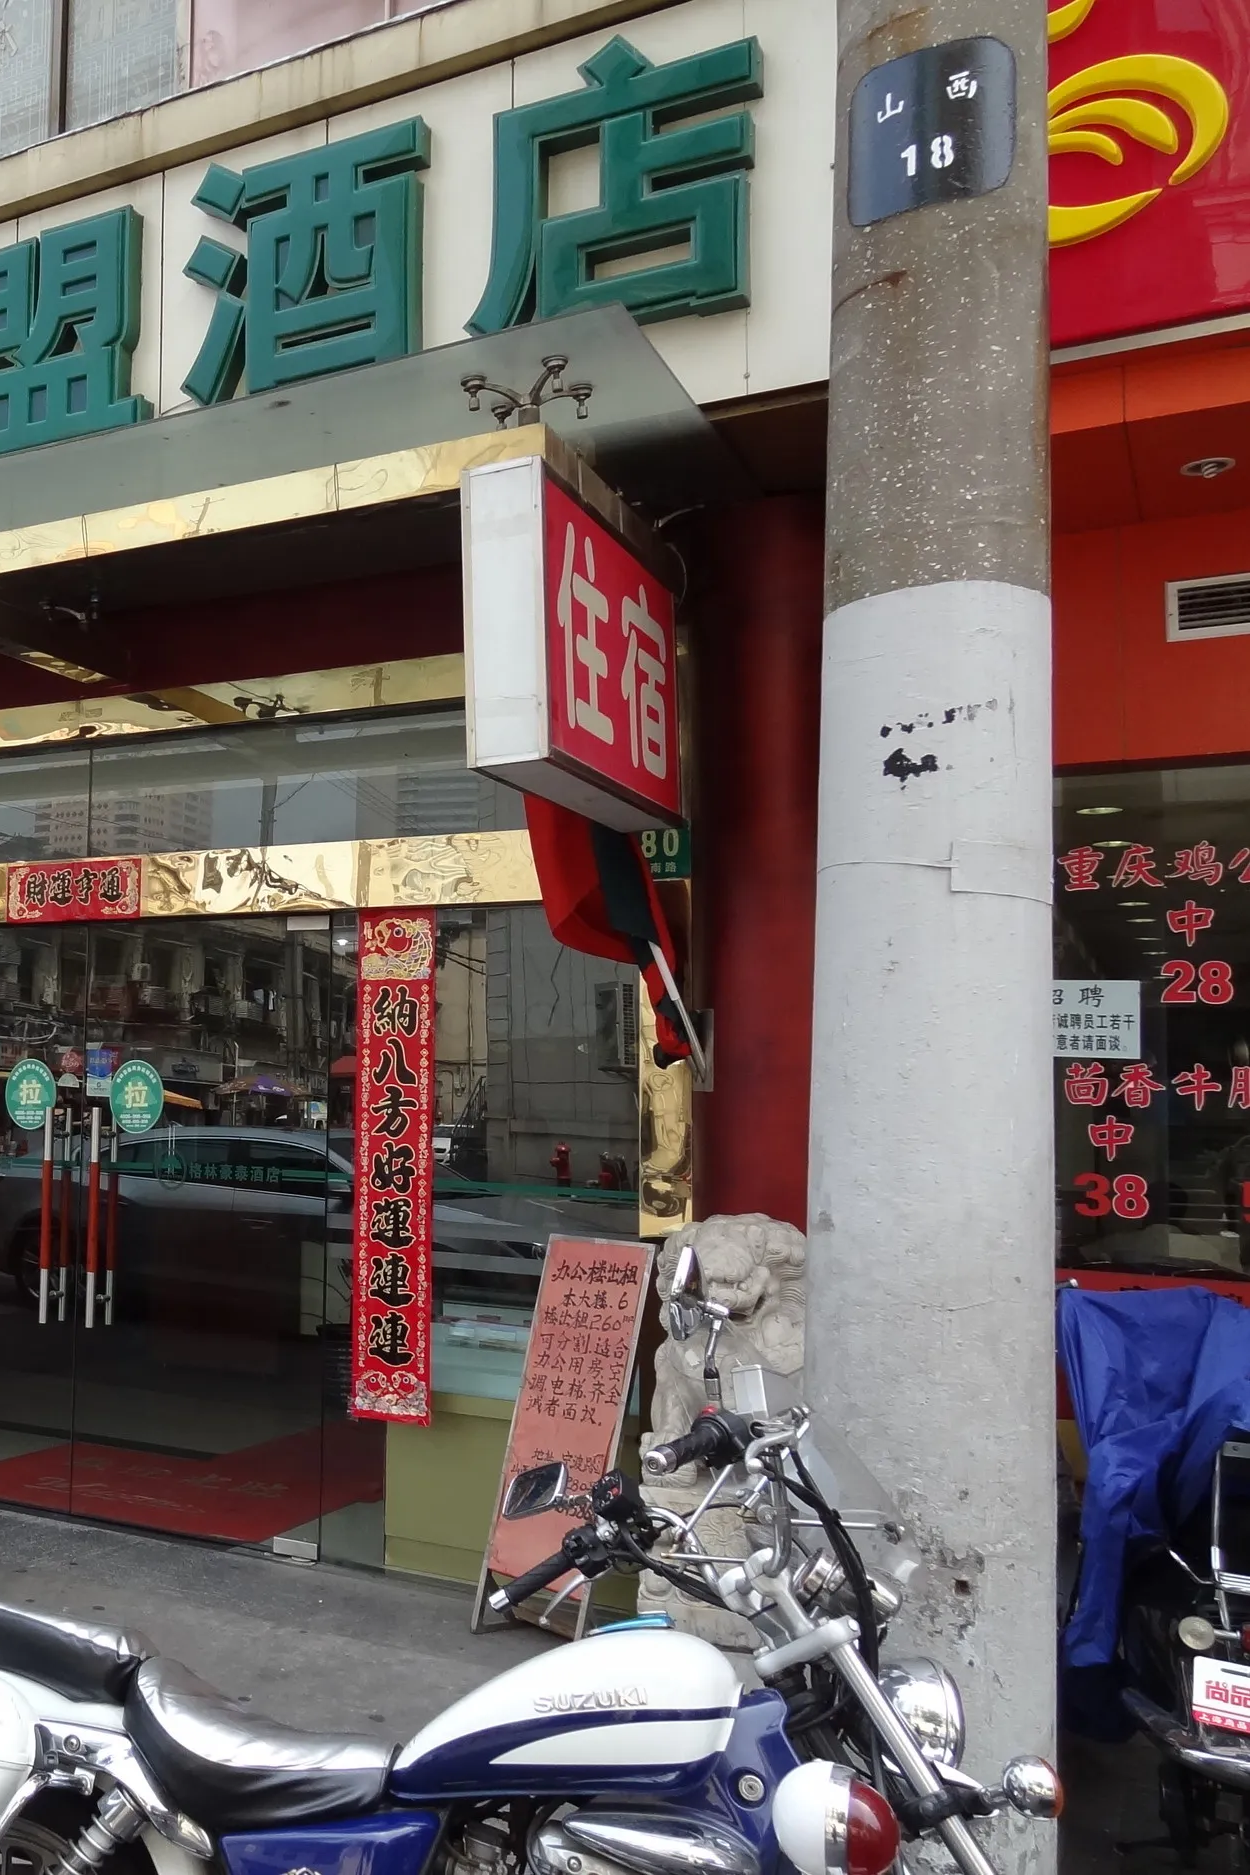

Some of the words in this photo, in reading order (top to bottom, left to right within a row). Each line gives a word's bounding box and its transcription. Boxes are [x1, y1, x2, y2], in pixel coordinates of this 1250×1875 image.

[876, 70, 978, 124] 山西
[900, 135, 955, 177] 18
[556, 520, 667, 781] 住宿
[1166, 900, 1215, 947] 中
[1161, 959, 1234, 1005] 28
[1053, 1013, 1136, 1031] 诚聘员工若干
[1053, 1034, 1128, 1052] 意者请面谈。
[19, 1079, 42, 1105] 拉
[124, 1081, 149, 1109] 拉
[1088, 1115, 1135, 1162] 中
[189, 1162, 284, 1186] 格林豪泰酒店
[1073, 1173, 1150, 1220] 38
[551, 1260, 639, 1286] 办公楼出租
[534, 1685, 648, 1713] SUZUKI
